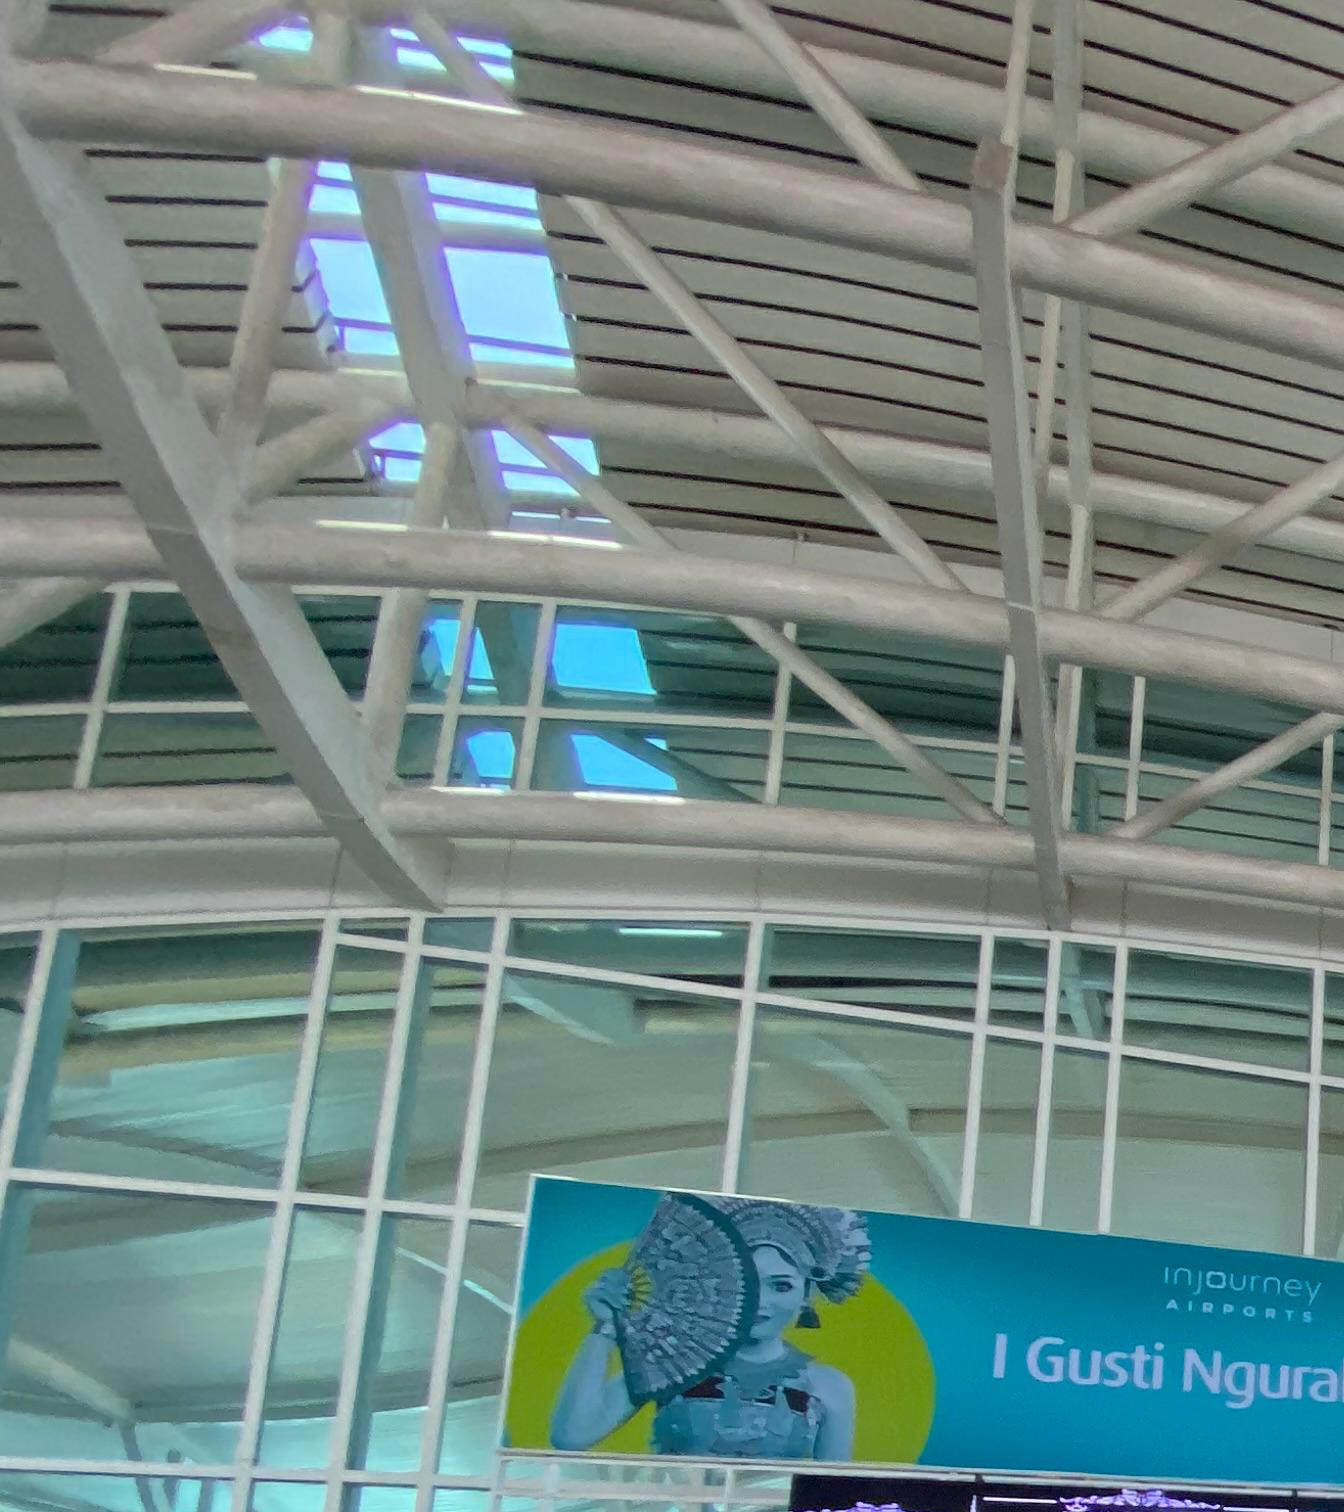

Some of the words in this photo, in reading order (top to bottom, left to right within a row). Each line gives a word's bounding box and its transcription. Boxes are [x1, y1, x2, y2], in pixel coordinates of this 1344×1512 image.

[1165, 1299, 1314, 1324] AIRPORTS
[993, 1332, 1008, 1379] I
[1025, 1336, 1165, 1390] Gusti
